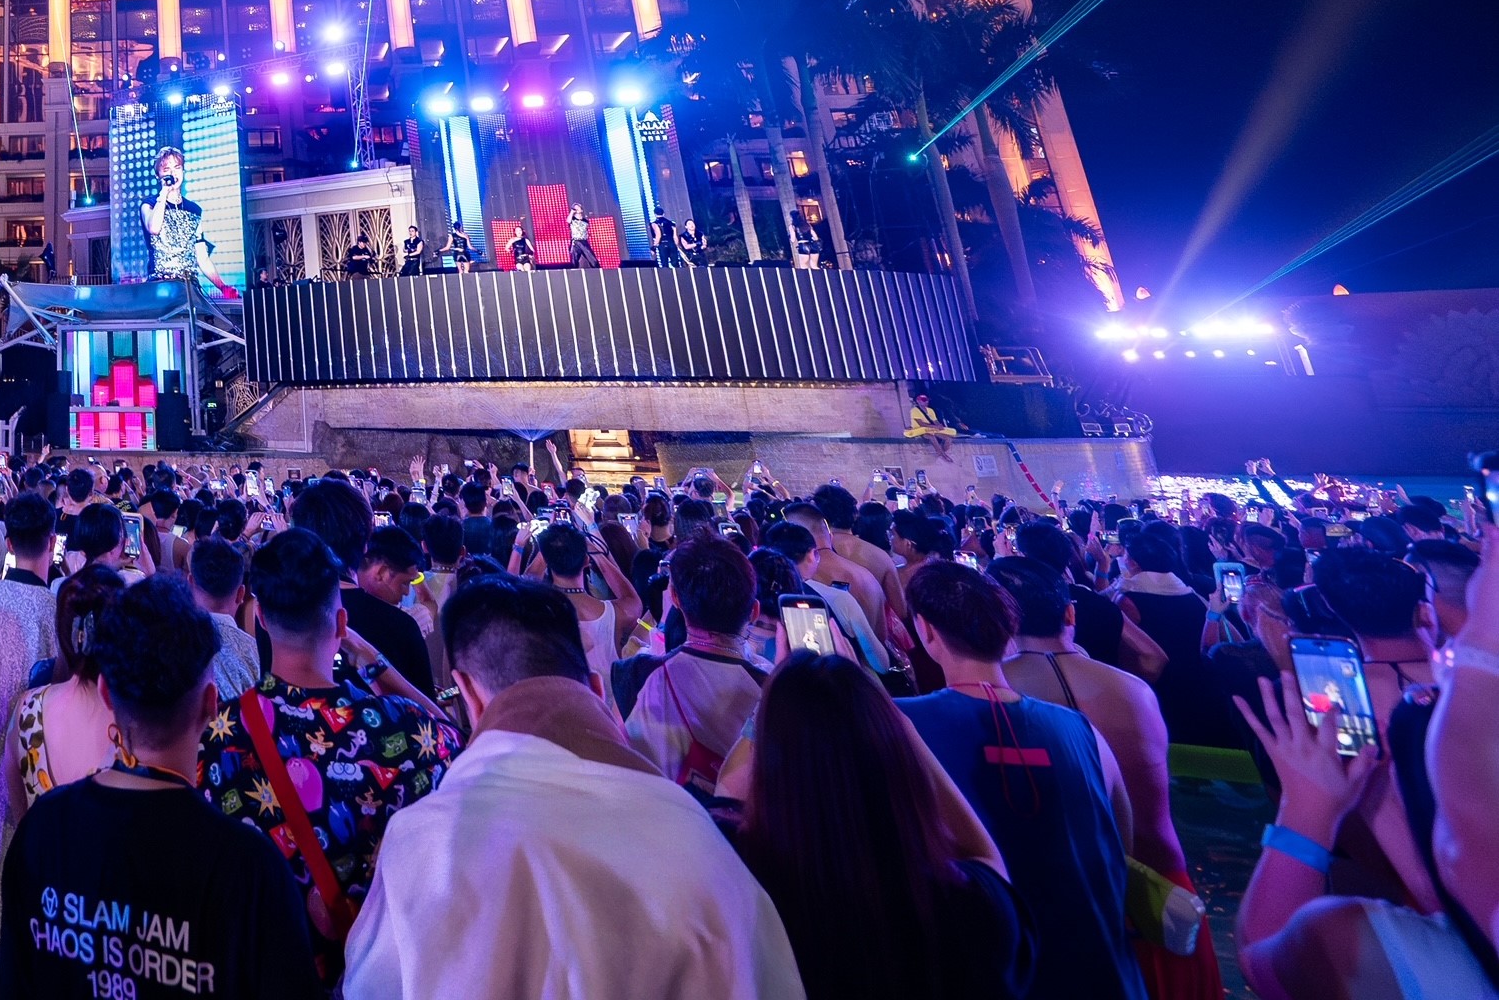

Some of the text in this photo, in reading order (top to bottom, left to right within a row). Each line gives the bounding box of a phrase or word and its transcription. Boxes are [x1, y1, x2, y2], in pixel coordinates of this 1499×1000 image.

[635, 120, 671, 130] GALAXY
[63, 892, 190, 953] SLAM JAM
[30, 917, 215, 994] CHAOS IS ORDER
[87, 969, 136, 1000] 1989
